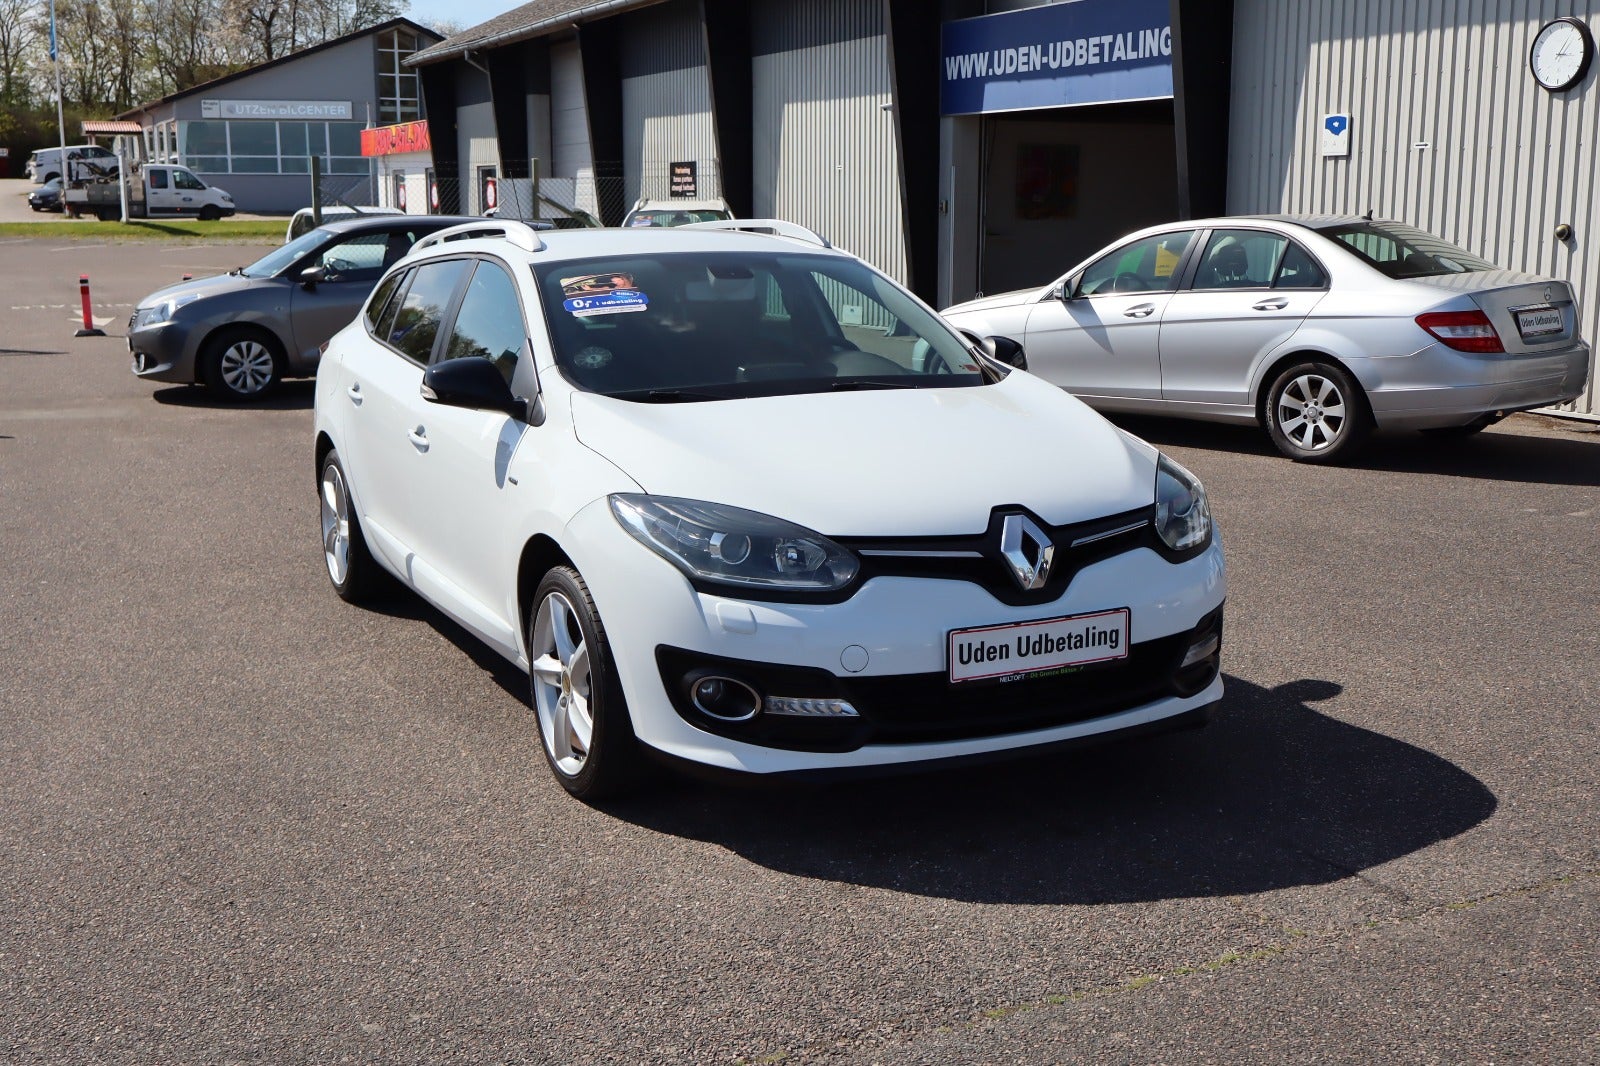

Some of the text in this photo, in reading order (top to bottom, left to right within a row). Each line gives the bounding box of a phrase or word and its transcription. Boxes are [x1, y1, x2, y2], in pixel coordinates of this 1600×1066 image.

[946, 26, 1172, 80] WWW.UDEN-UDBETALING
[279, 104, 346, 115] BILCENTER
[959, 626, 1119, 665] Uden Udbetaling
